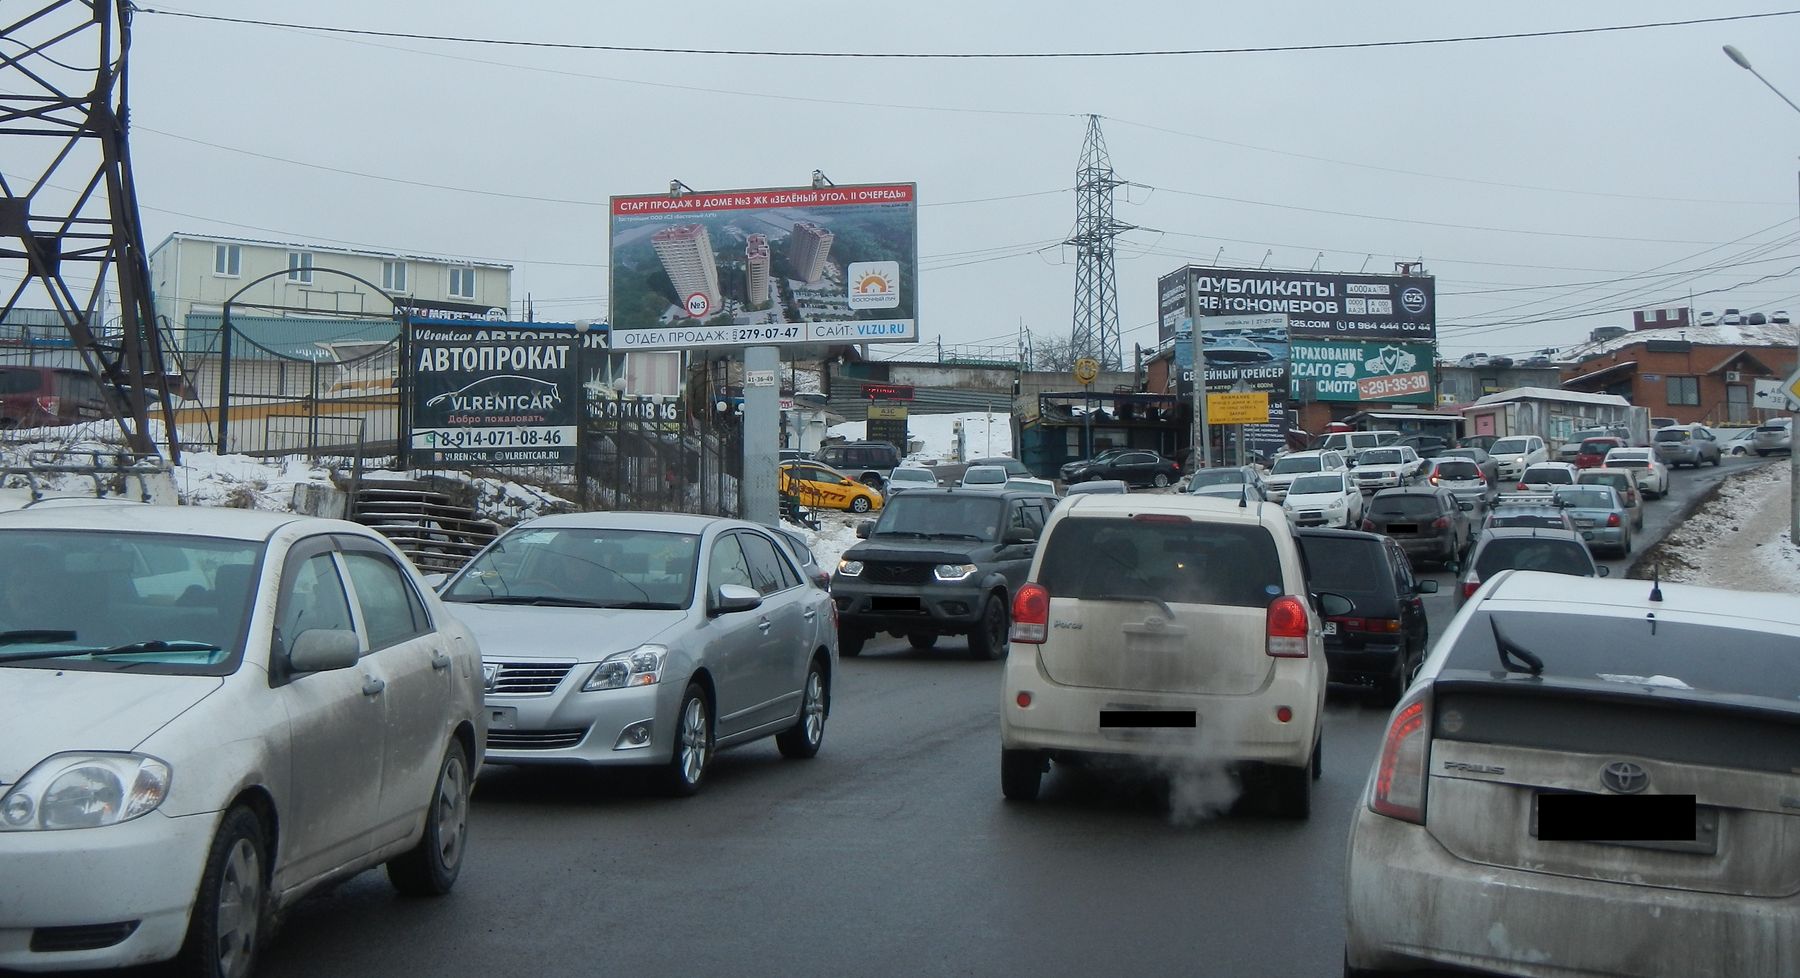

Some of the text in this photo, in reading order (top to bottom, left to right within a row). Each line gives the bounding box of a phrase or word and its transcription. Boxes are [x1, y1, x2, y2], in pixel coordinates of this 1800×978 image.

[620, 190, 906, 211] СТАРТ ПРОДАЖ В ДОМЕ №3 ЖК «ЗЕЛЁНЫЙ УГОЛ. II ОЧЕРЕДЬ»
[1197, 276, 1335, 297] ДУБЛИКАТЫ
[690, 301, 706, 309] №3
[1199, 295, 1339, 314] АВТОНОМЕРОВ
[624, 332, 666, 345] ОТДЕЛ
[668, 329, 729, 343] ПРОДАЖ:
[739, 327, 799, 340] 279-07-47
[815, 323, 853, 337] САЙТ:
[857, 323, 905, 335] VLZU.RU
[1348, 321, 1356, 329] 8
[1379, 322, 1399, 330] 444
[1402, 322, 1416, 331] 00
[1418, 323, 1431, 331] 44
[416, 329, 472, 341] Vlrentcar
[418, 345, 570, 372] АВТОПРОКАТ
[1183, 365, 1285, 381] СЕЕЙНЫЙ КРЕЙСЕР
[1368, 374, 1427, 395] 291-35-30
[449, 395, 554, 411] VLRENTCAR
[447, 414, 545, 425] Добро пожаловать
[441, 429, 561, 446] 8-914-071-08-46
[504, 450, 560, 461] VLRENTCAR.RU
[1444, 761, 1505, 776] PRIUS
